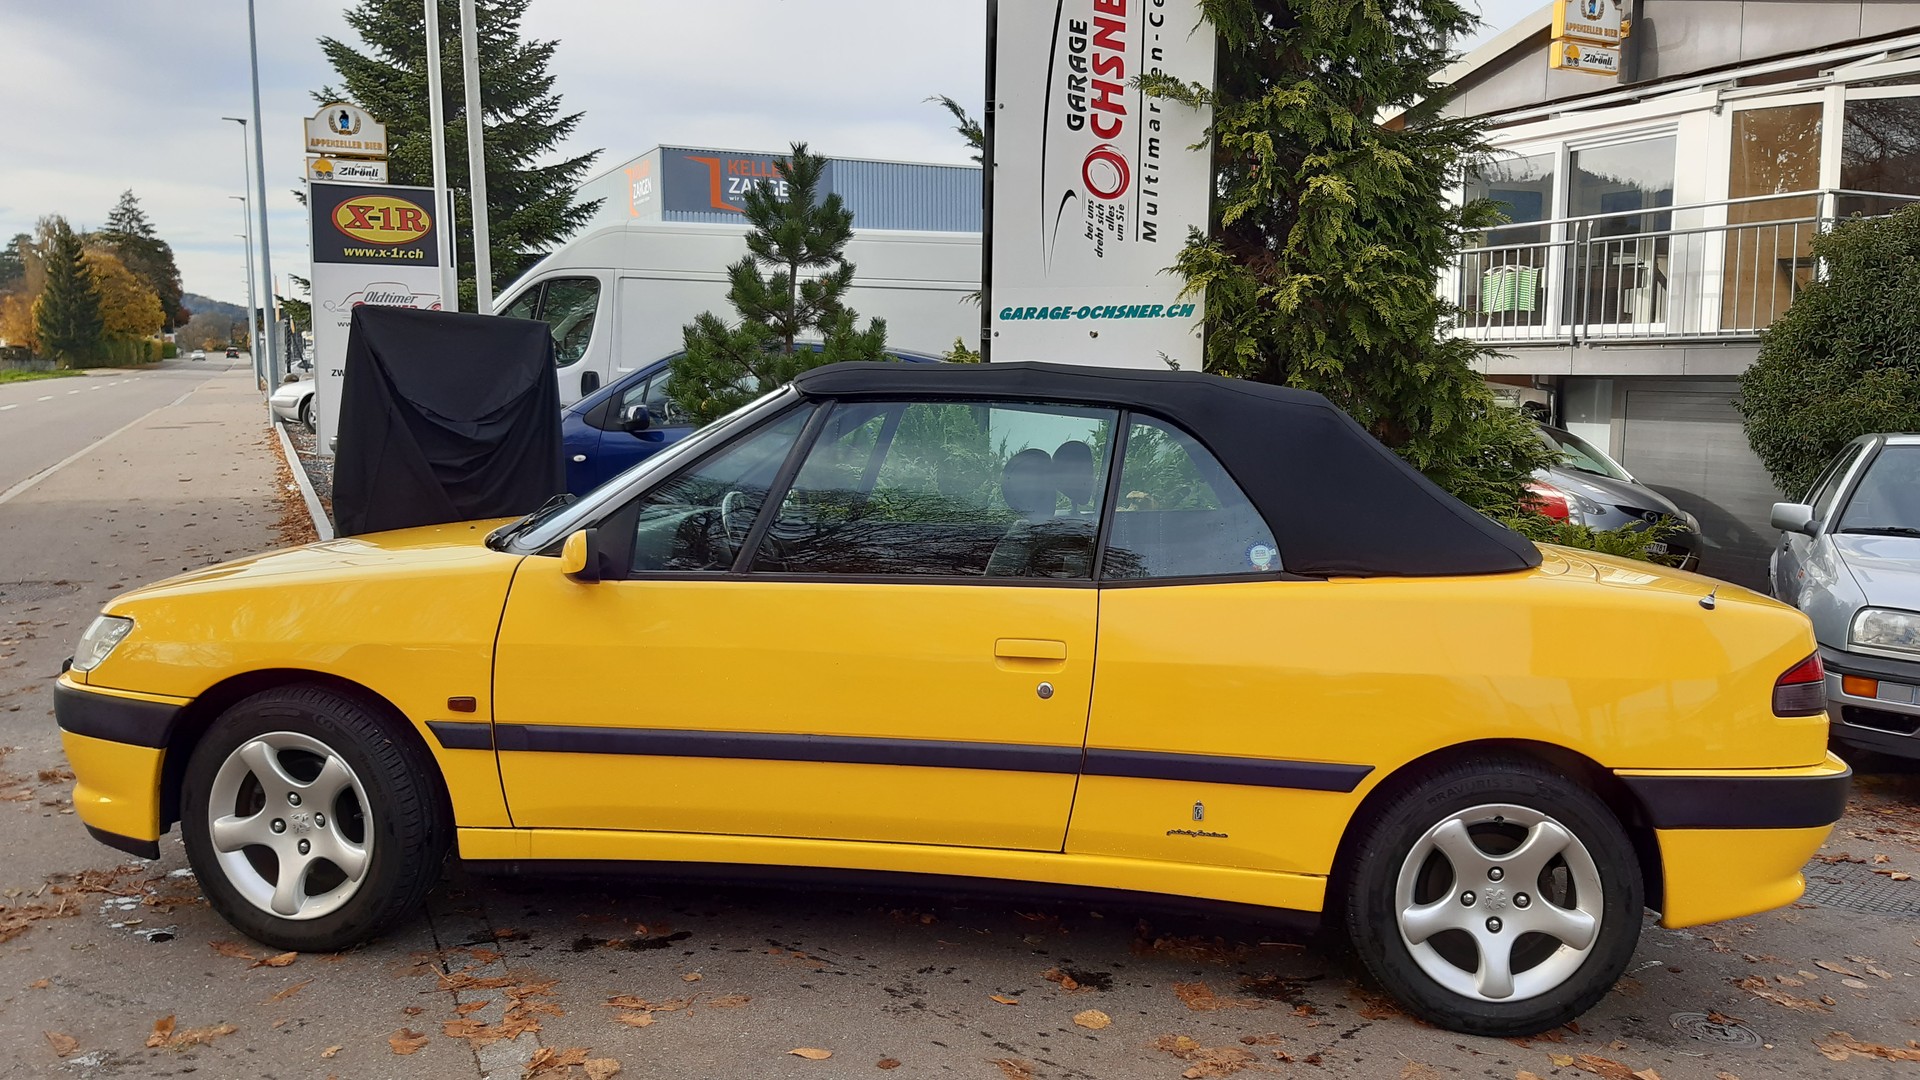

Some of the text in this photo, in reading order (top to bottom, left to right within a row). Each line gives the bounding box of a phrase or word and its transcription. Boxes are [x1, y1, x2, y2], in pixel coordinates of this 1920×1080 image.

[1604, 28, 1618, 37] BIER
[1067, 19, 1088, 132] GARAGE
[1142, 0, 1164, 243] Multimaren-Ce
[311, 138, 383, 150] APPENZELLER BIER
[727, 159, 794, 178] KELLE
[728, 177, 795, 197] ZAGE
[344, 205, 426, 232] X-1R
[1105, 204, 1115, 231] alles
[1116, 204, 1125, 241] um Sie
[1084, 220, 1094, 240] bei
[1094, 203, 1104, 258] dreht sich
[343, 247, 424, 259] www.x-1r.ch
[364, 290, 418, 304] Oldtimer
[1000, 304, 1195, 320] GARAGE-OCHSNER.CH
